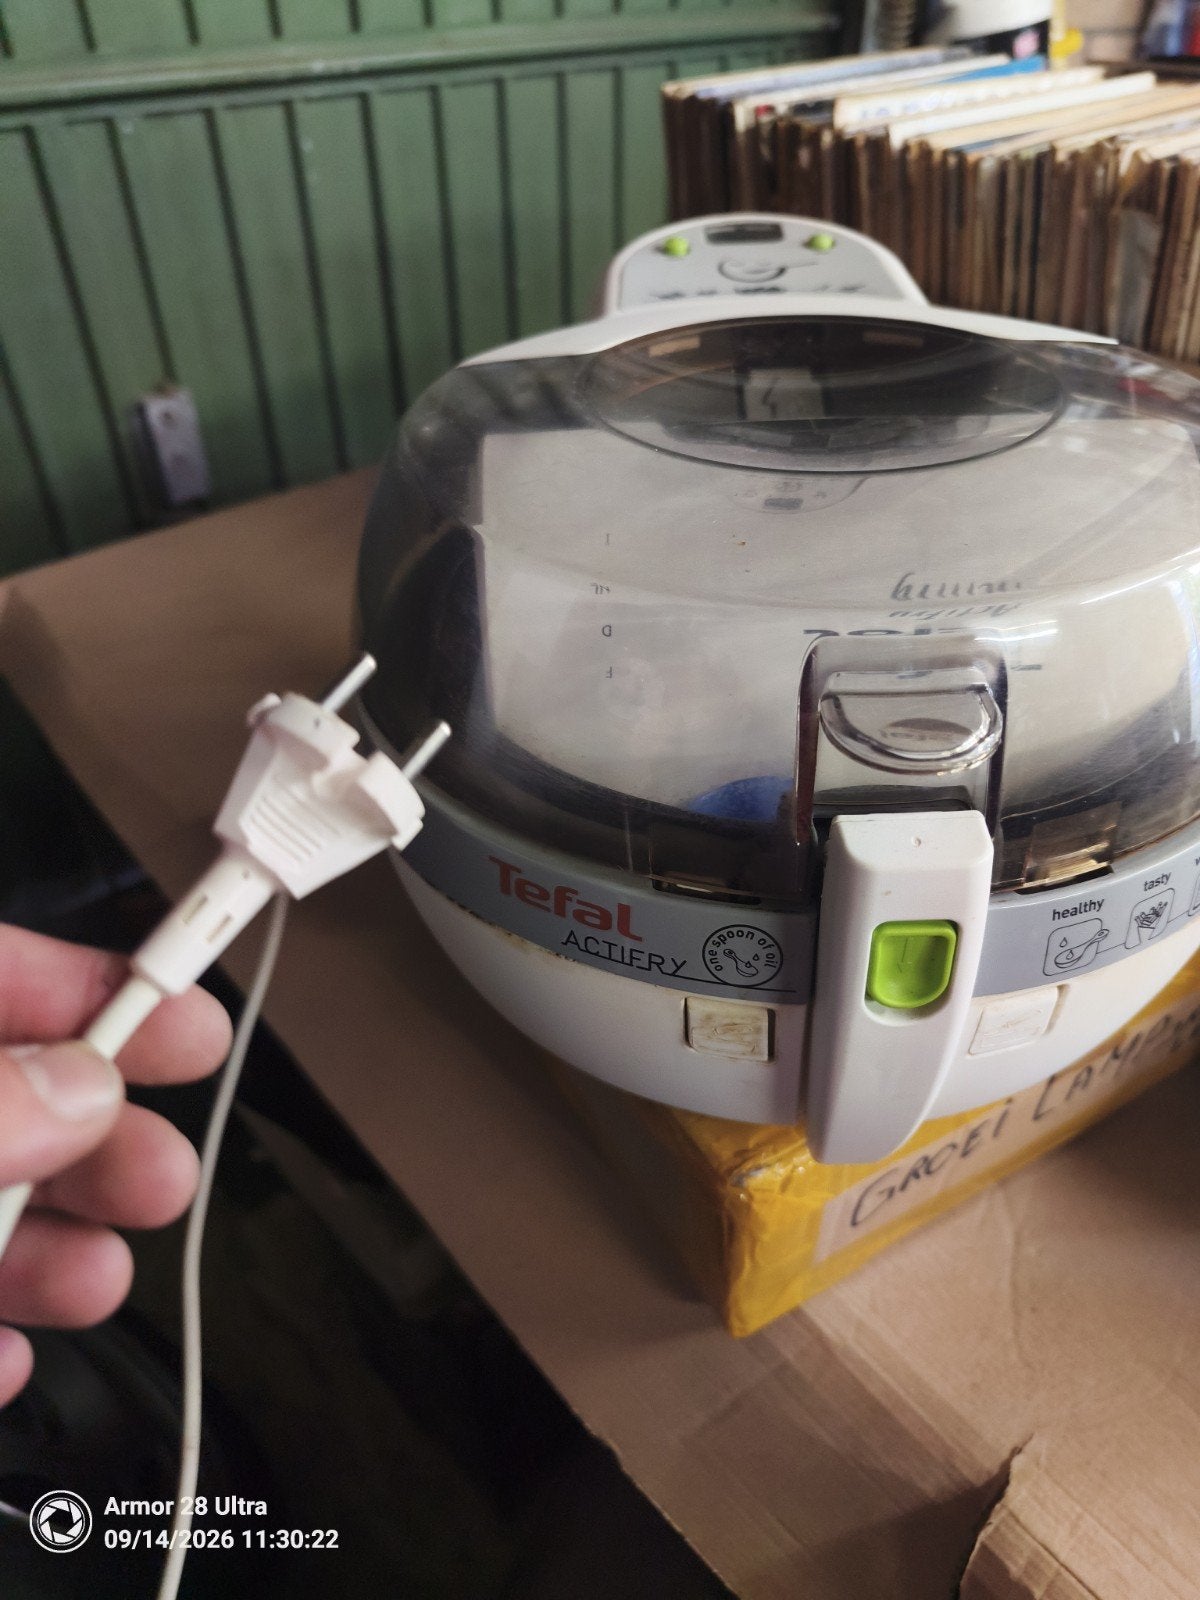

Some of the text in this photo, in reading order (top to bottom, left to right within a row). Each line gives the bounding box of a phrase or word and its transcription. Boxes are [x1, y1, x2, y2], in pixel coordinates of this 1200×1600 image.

[488, 855, 643, 942] Tefal
[1143, 872, 1172, 892] tasty
[1052, 898, 1105, 922] healthy
[708, 930, 779, 972] one spoon of oil
